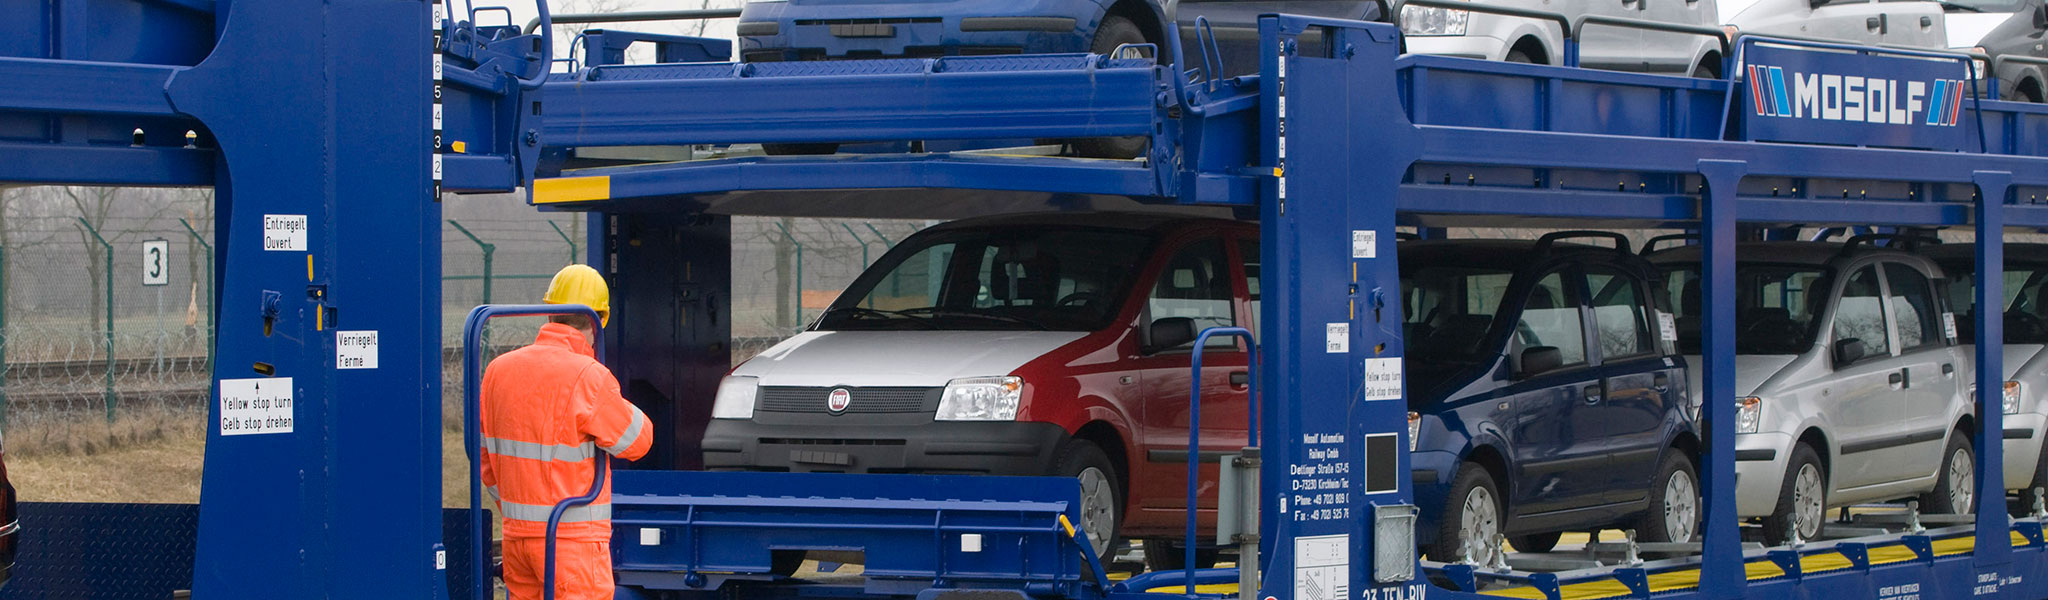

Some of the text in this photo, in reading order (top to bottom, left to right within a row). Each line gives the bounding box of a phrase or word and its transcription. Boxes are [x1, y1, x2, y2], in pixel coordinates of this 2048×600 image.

[434, 10, 441, 23] 8
[434, 35, 441, 48] 7
[434, 60, 441, 73] 6
[434, 85, 442, 98] 5
[1794, 72, 1926, 125] MOSOLF
[434, 110, 441, 123] 4
[434, 135, 442, 148] 3
[434, 160, 441, 174] 2
[435, 185, 440, 199] 1
[266, 216, 306, 233] Entriegelt
[266, 236, 292, 249] Ouvert
[150, 247, 161, 278] 3
[338, 333, 377, 348] Verriegelt
[339, 354, 364, 367] Fermé
[222, 396, 292, 412] Yellow stop turn
[833, 394, 847, 406] FIAT
[222, 416, 292, 432] Gelb stop drehen
